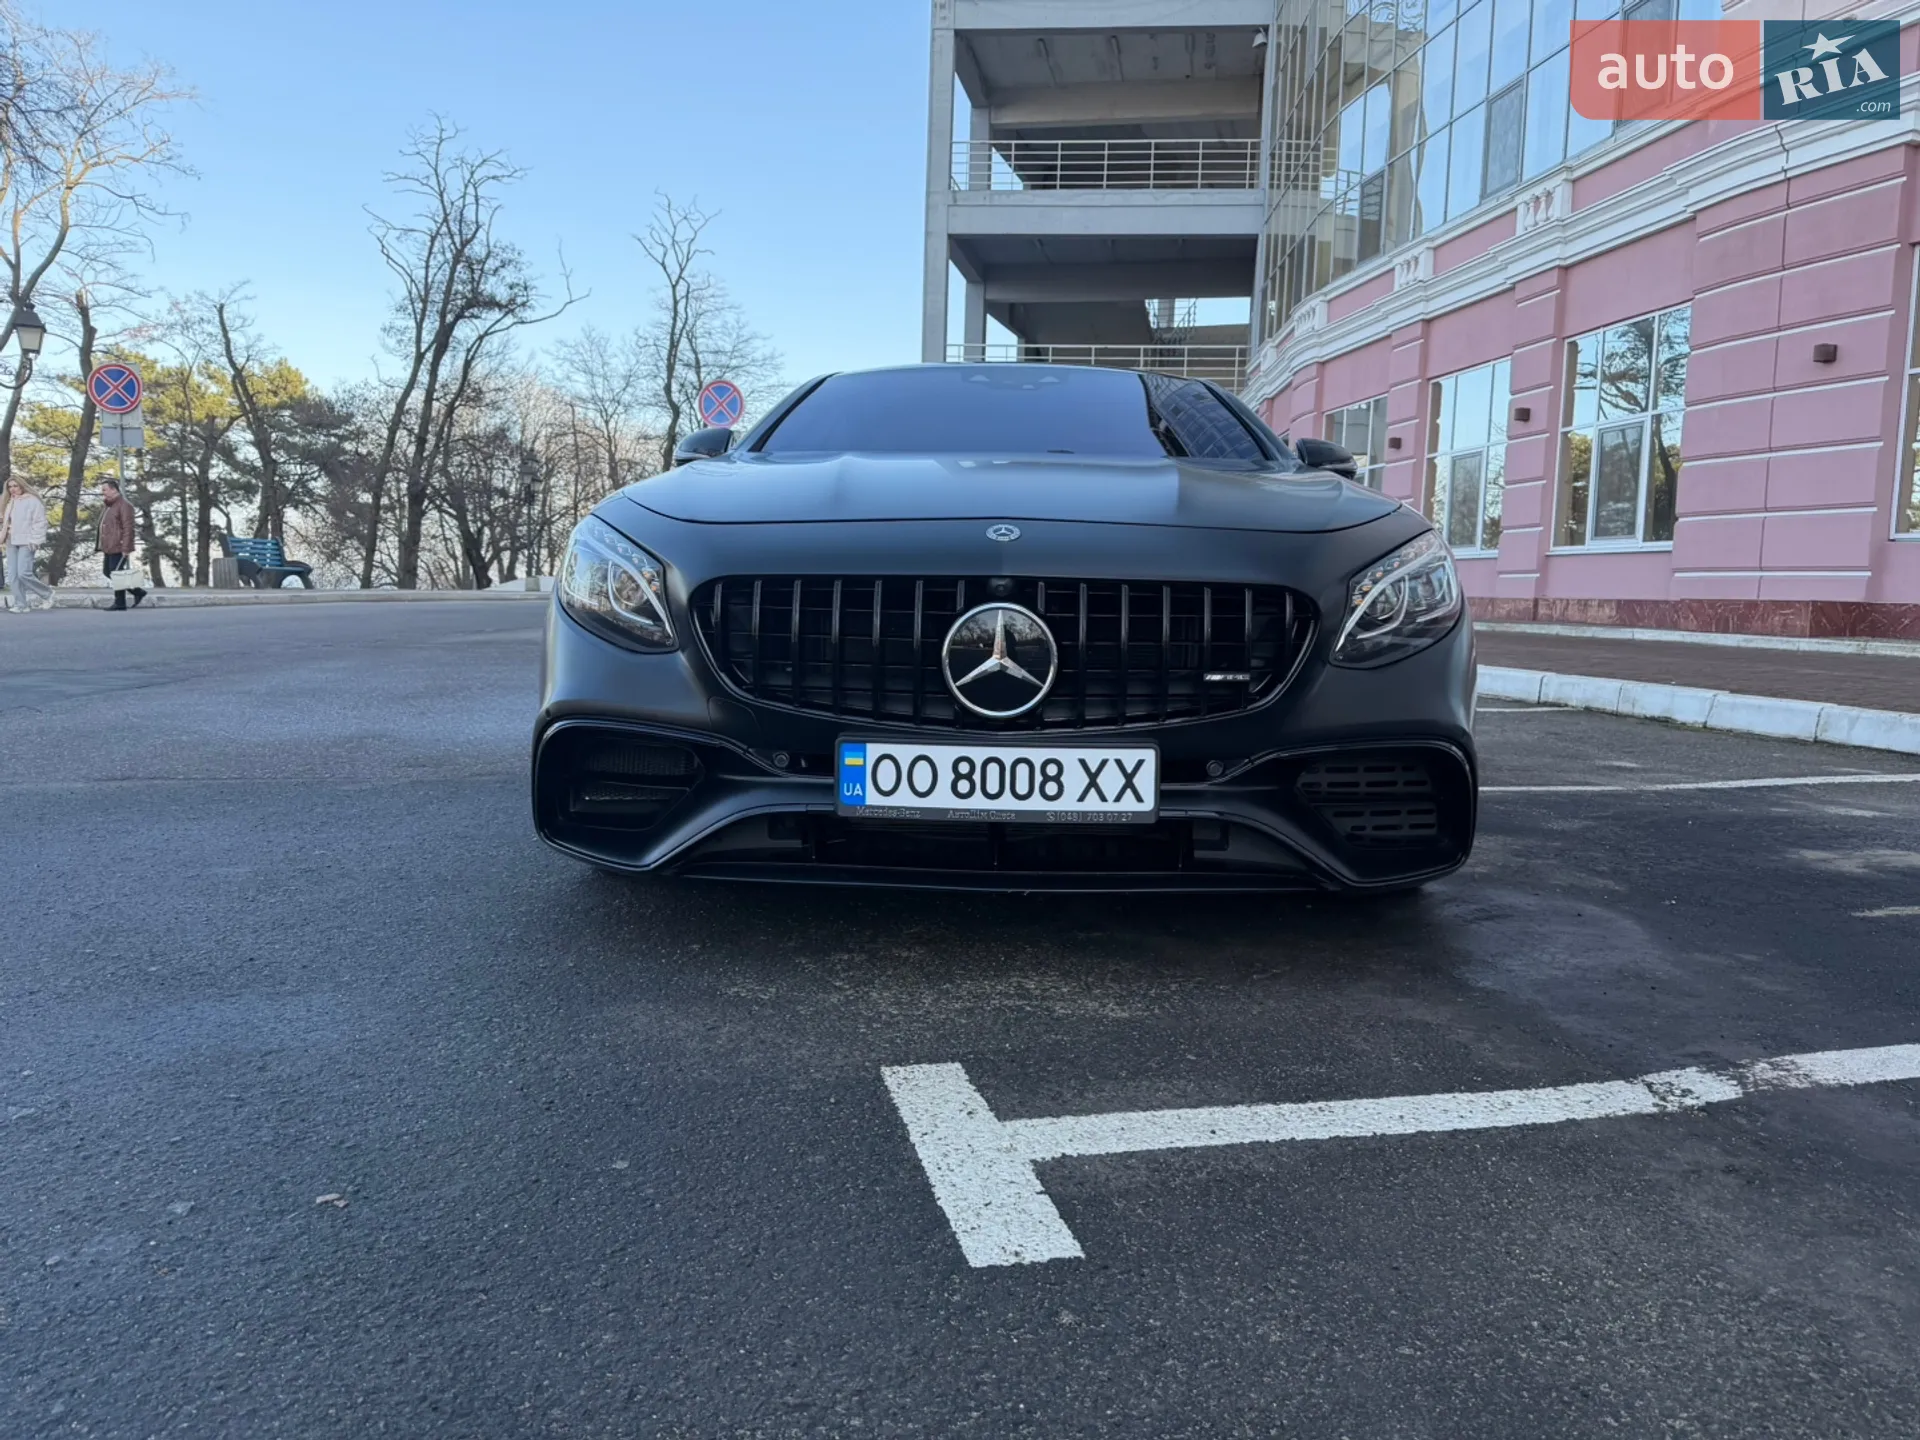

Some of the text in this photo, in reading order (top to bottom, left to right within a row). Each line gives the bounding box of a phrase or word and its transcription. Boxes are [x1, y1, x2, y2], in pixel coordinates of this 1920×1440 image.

[843, 783, 863, 797] UA
[870, 753, 1146, 804] OO 8008 XX
